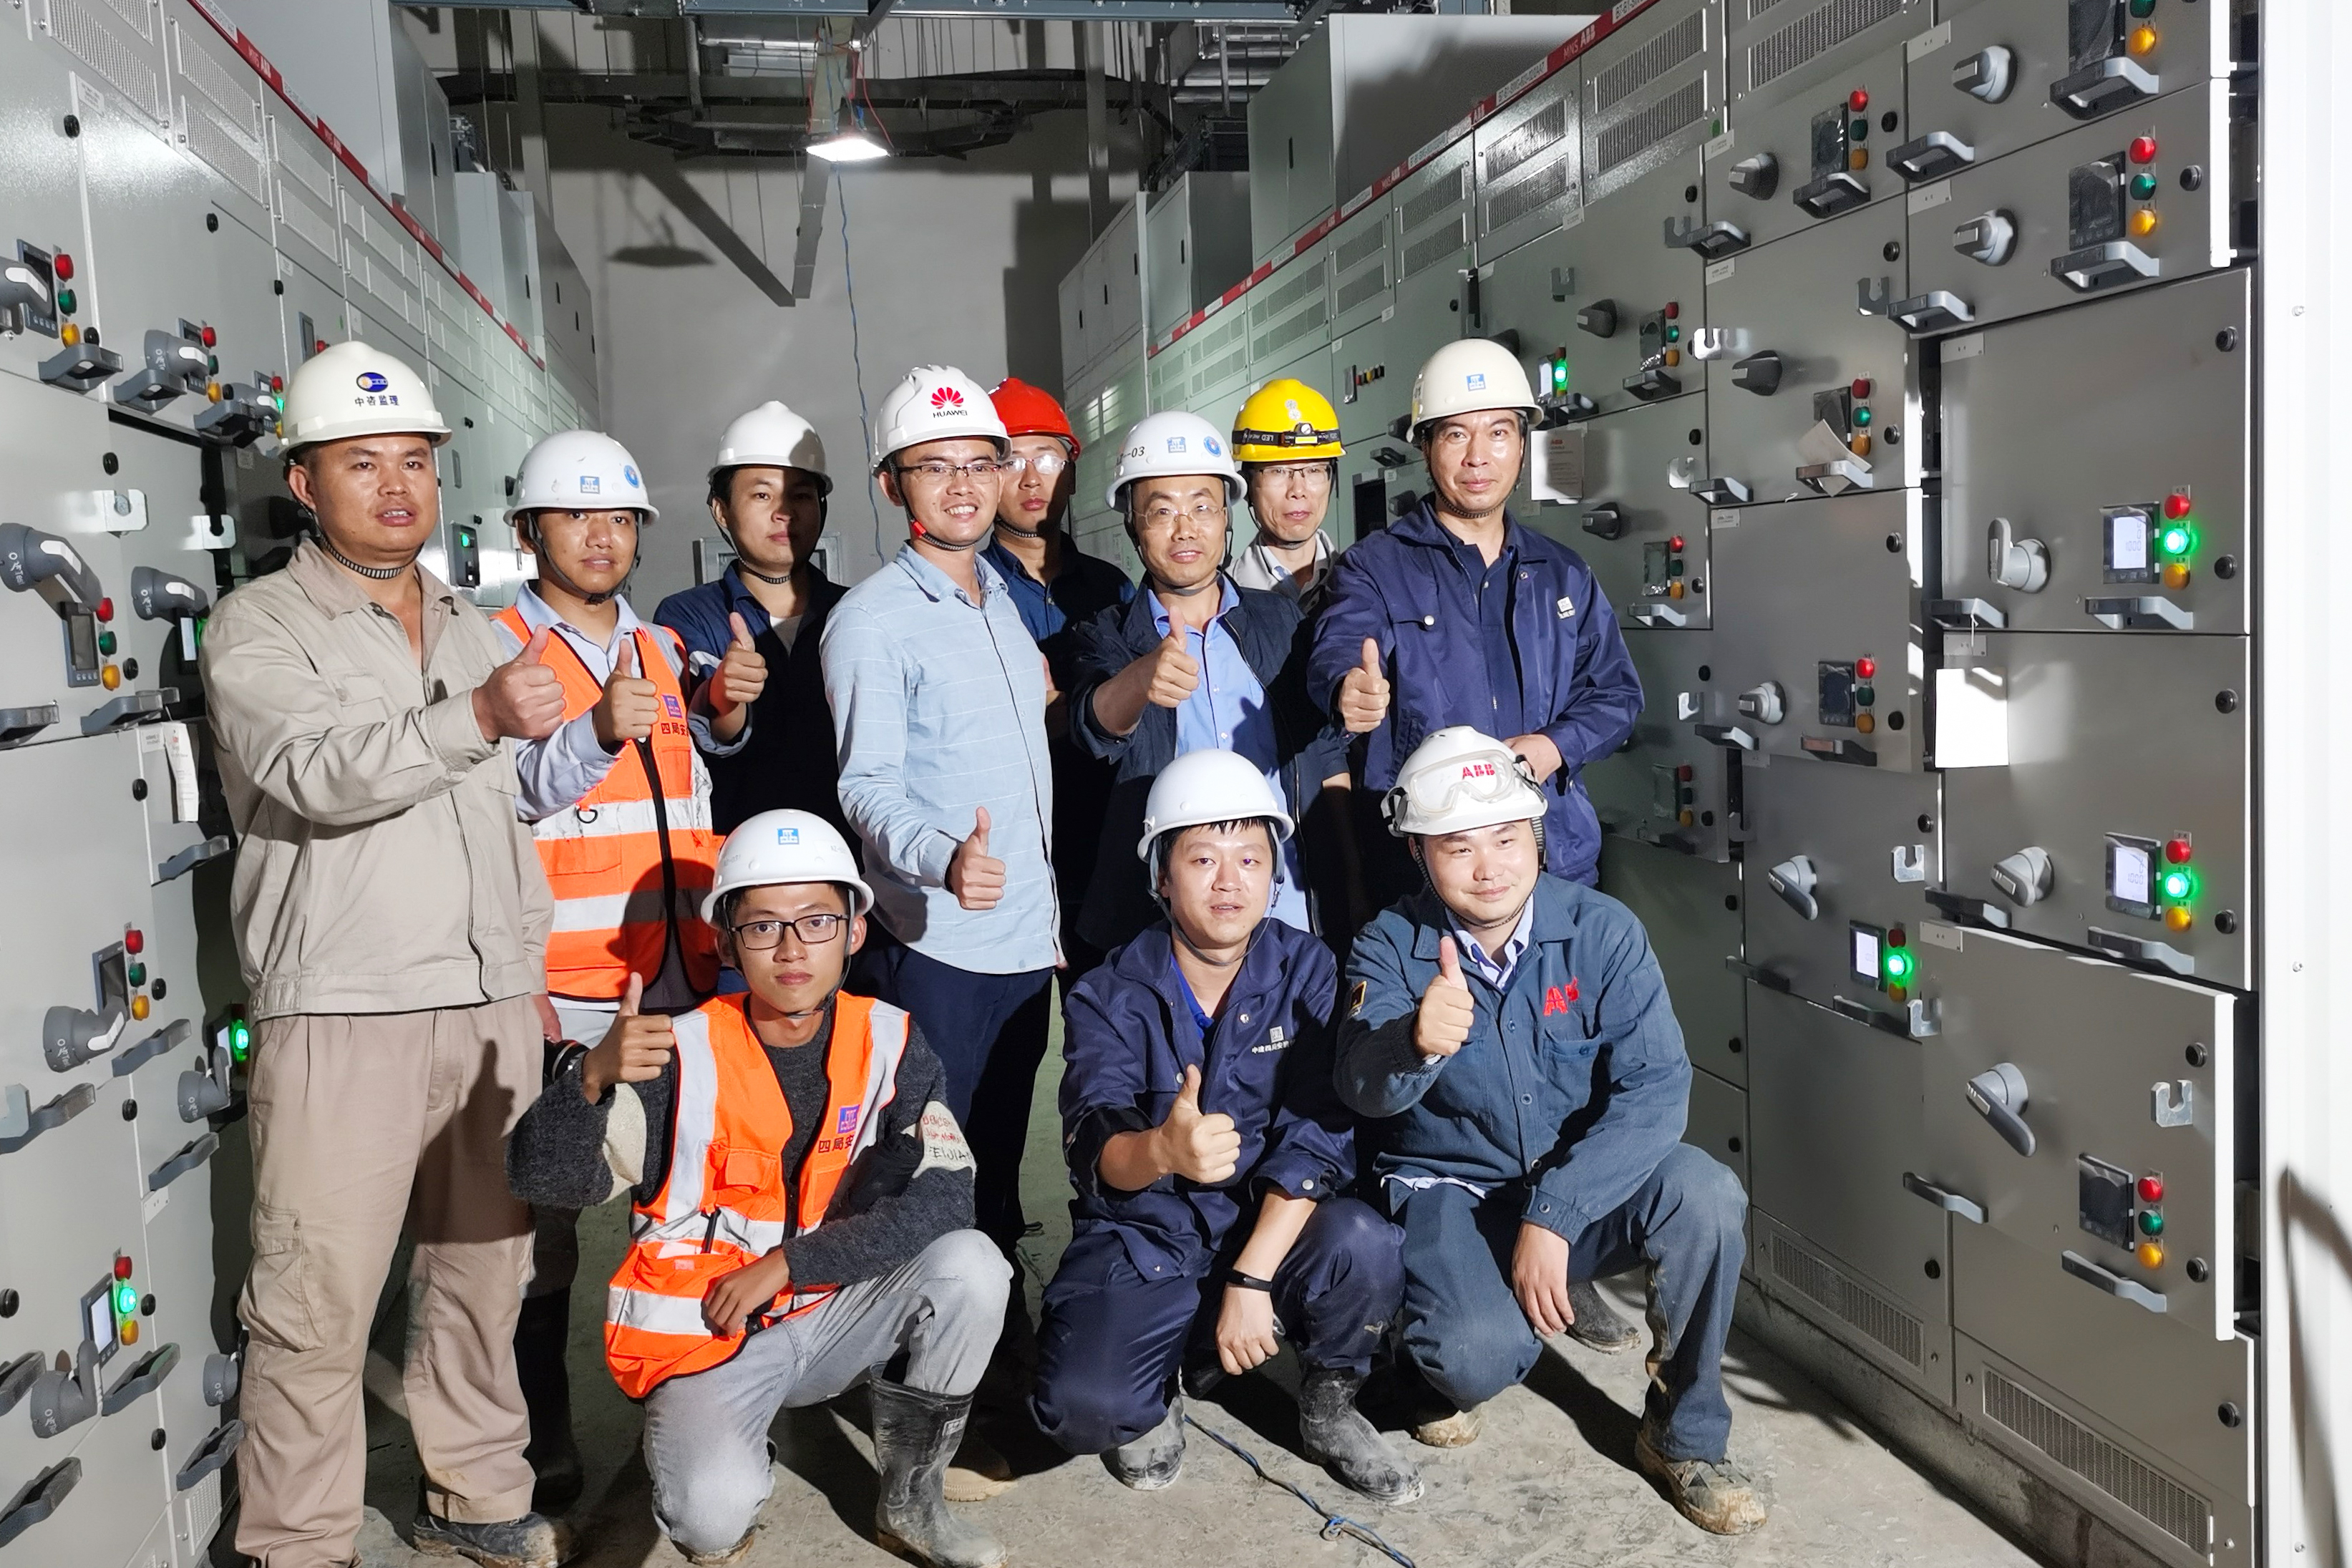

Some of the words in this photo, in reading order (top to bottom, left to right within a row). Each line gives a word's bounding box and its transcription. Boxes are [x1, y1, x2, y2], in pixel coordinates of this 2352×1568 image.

[1563, 40, 1580, 62] MNS
[1580, 24, 1596, 49] ABB
[354, 394, 399, 406] 中咨监理
[933, 409, 968, 419] HUAWEI
[1462, 764, 1495, 780] ABB
